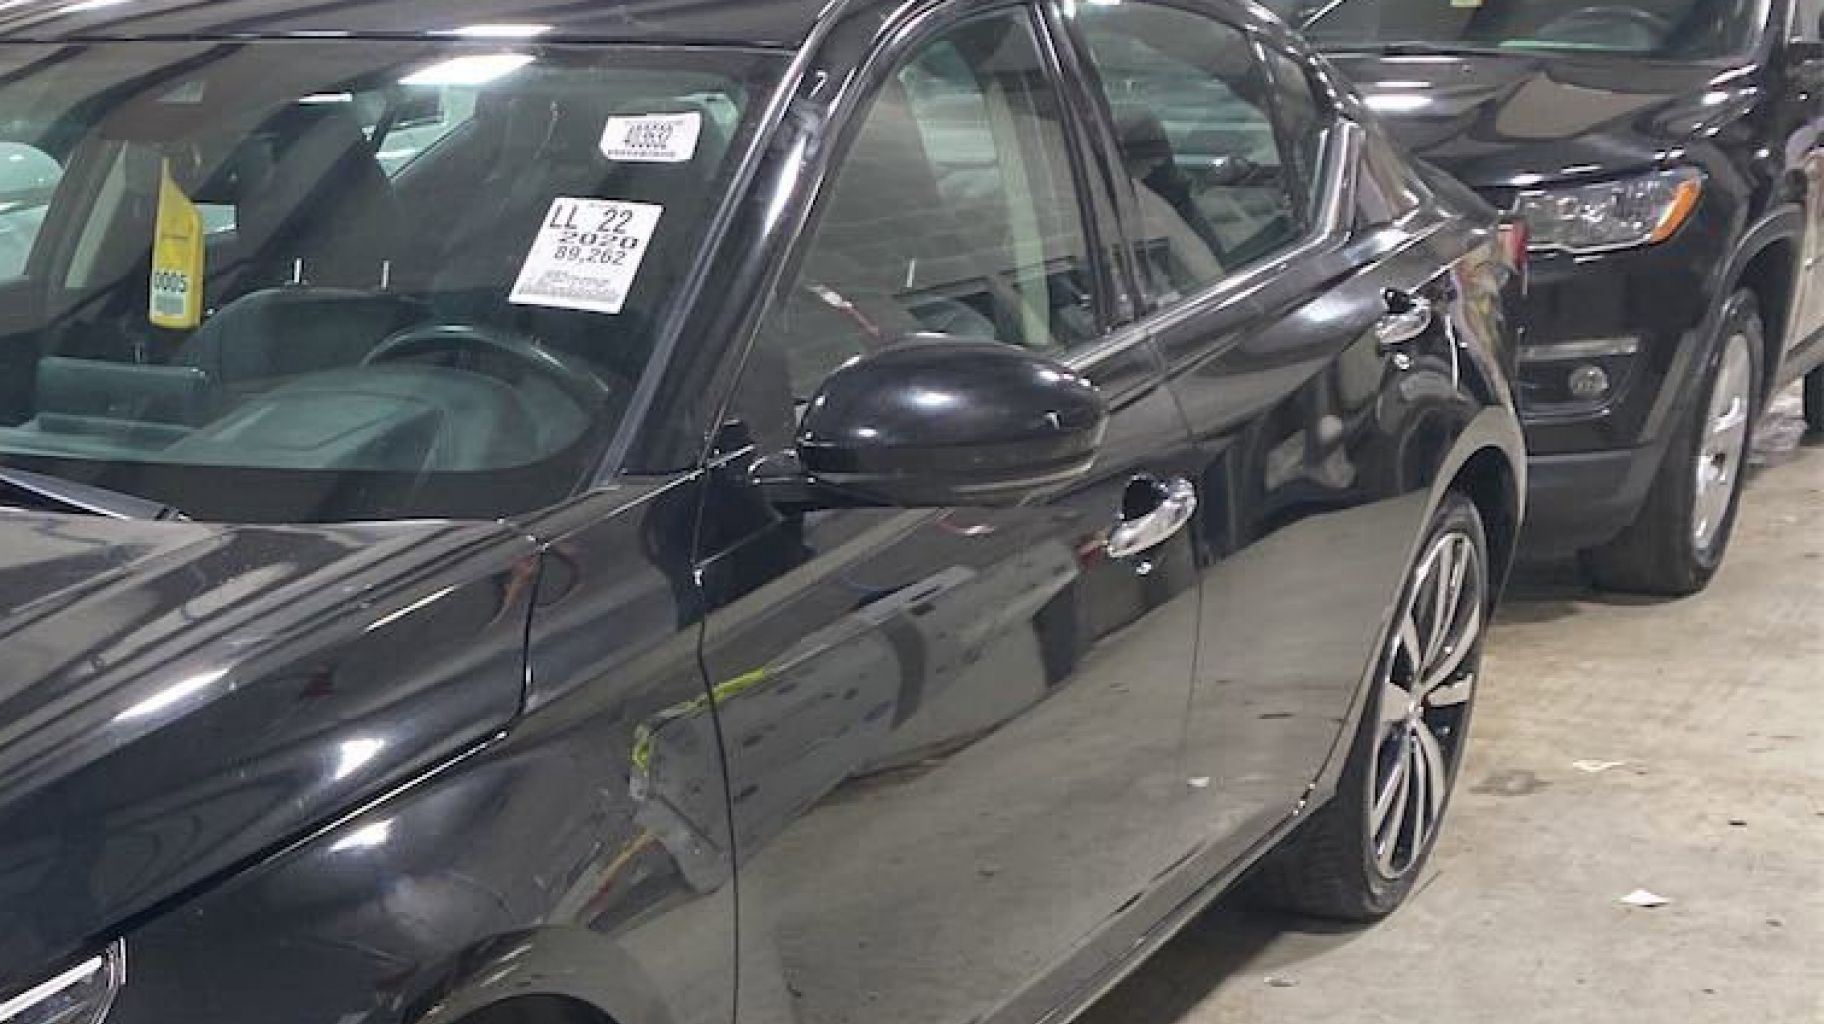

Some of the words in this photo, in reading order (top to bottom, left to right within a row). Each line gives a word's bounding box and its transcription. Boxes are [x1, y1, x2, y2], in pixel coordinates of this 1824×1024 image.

[549, 203, 578, 230] LL
[597, 207, 634, 234] 22
[558, 231, 639, 250] 2020
